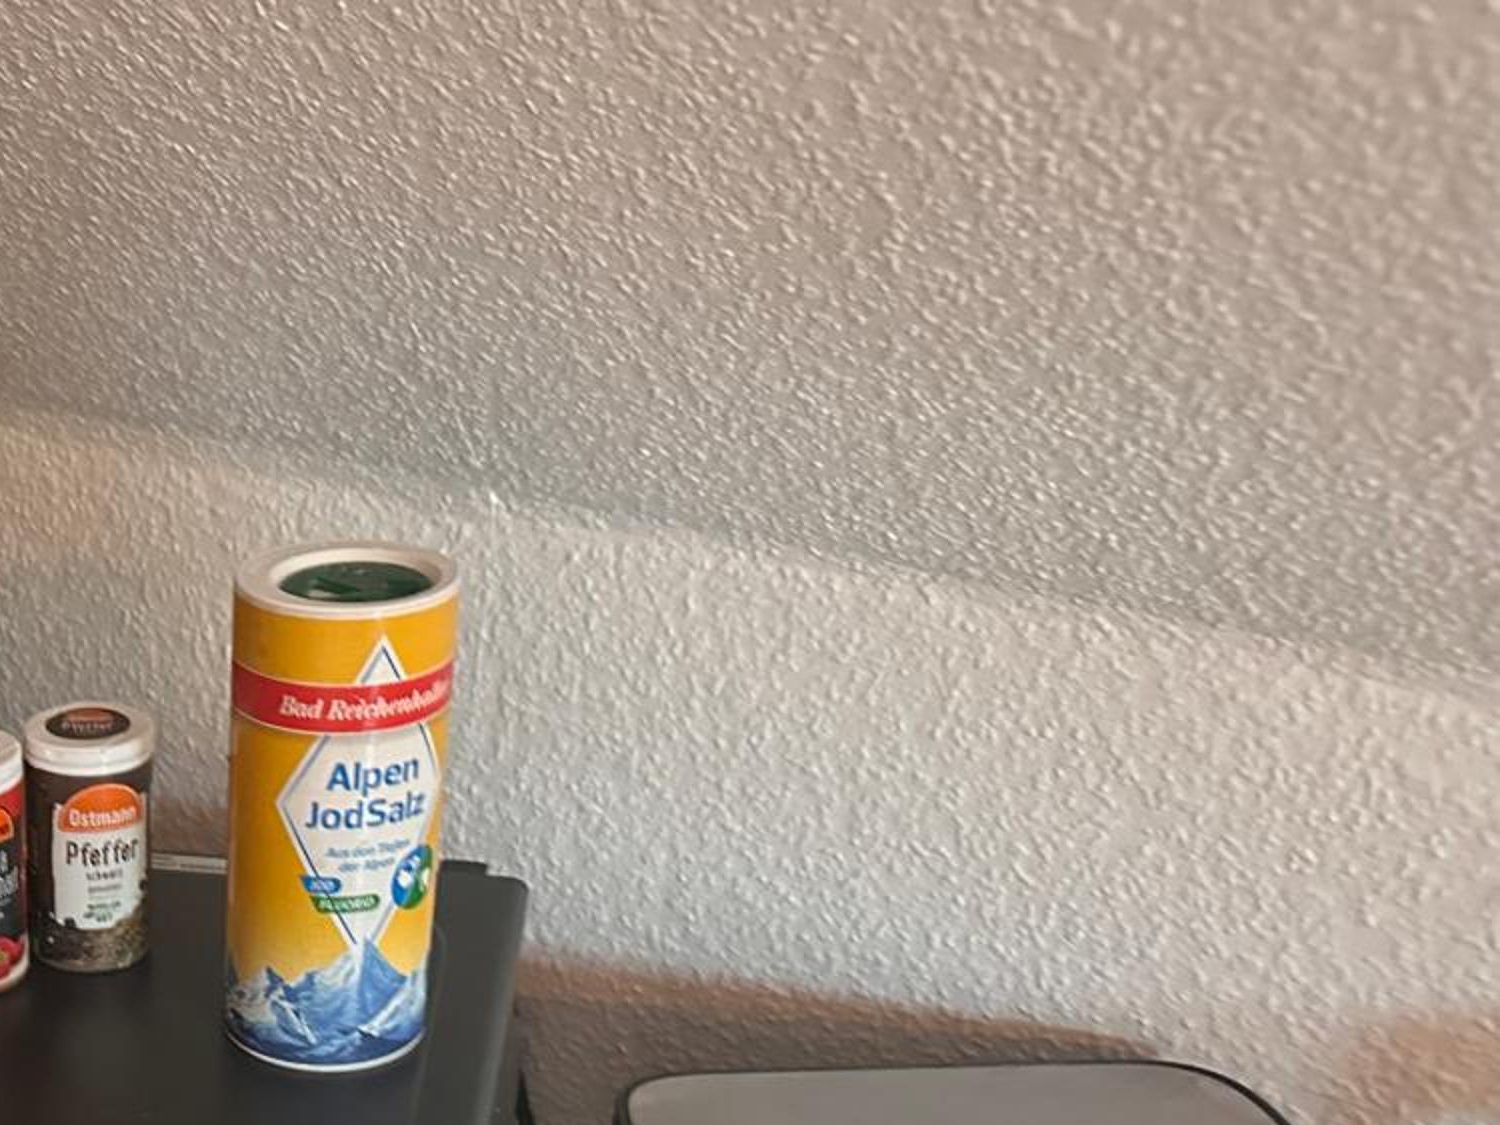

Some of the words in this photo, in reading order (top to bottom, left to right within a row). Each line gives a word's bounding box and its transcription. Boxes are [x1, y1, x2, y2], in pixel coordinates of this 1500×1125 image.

[280, 694, 323, 719] Bad
[327, 757, 419, 797] Alpen
[68, 805, 137, 829] Ostmann
[306, 790, 425, 830] JodSalz
[66, 838, 139, 868] Pfeffer
